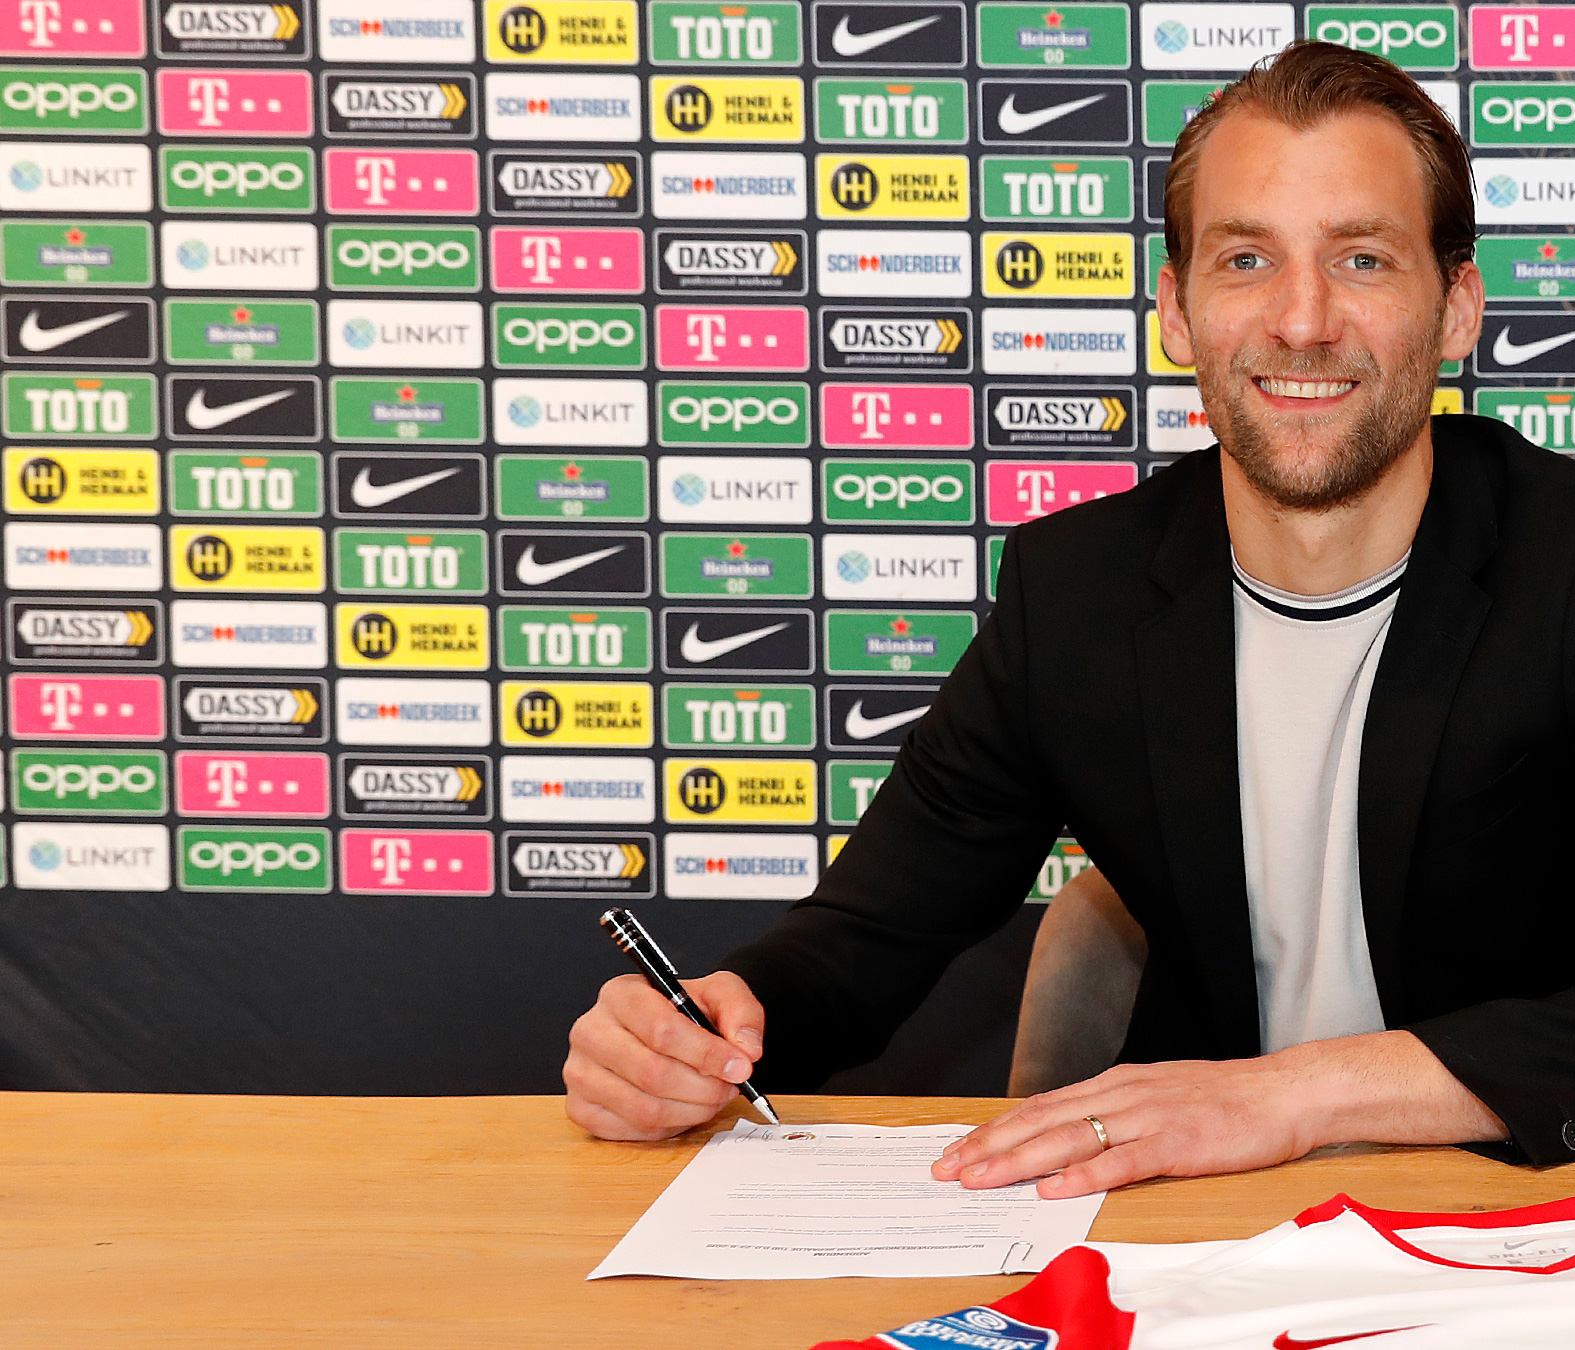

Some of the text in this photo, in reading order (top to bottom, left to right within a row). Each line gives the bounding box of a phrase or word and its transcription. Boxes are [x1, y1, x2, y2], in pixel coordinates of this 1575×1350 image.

[179, 11, 266, 33] DASSY
[559, 18, 605, 29] HENRI
[559, 34, 627, 46] HERMAN
[671, 16, 773, 59] TOTO
[1193, 27, 1282, 46] LINKIT
[347, 90, 433, 112] DASSY
[725, 97, 772, 108] HENRI
[726, 112, 793, 124] HERMAN
[837, 95, 939, 138] TOTO
[48, 167, 137, 187] LINKIT
[513, 169, 599, 190] DASSY
[891, 175, 937, 186] HENRI
[891, 191, 959, 202] HERMAN
[1002, 173, 1104, 215] TOTO
[215, 246, 304, 266] LINKIT
[679, 247, 765, 269] DASSY
[1056, 253, 1102, 264] HENRI
[1056, 268, 1123, 280] HERMAN
[381, 325, 470, 345] LINKIT
[844, 325, 930, 346] DASSY
[24, 389, 127, 432] TOTO
[546, 403, 635, 423] LINKIT
[1009, 403, 1094, 424] DASSY
[190, 467, 293, 510] TOTO
[711, 481, 800, 500] LINKIT
[356, 545, 458, 588] TOTO
[875, 558, 964, 577] LINKIT
[33, 616, 119, 638] DASSY
[521, 623, 623, 665] TOTO
[198, 694, 284, 715] DASSY
[685, 700, 787, 742] TOTO
[363, 771, 449, 793] DASSY
[66, 846, 155, 866] LINKIT
[528, 849, 613, 870] DASSY
[1488, 1247, 1568, 1259] DRI-FIT
